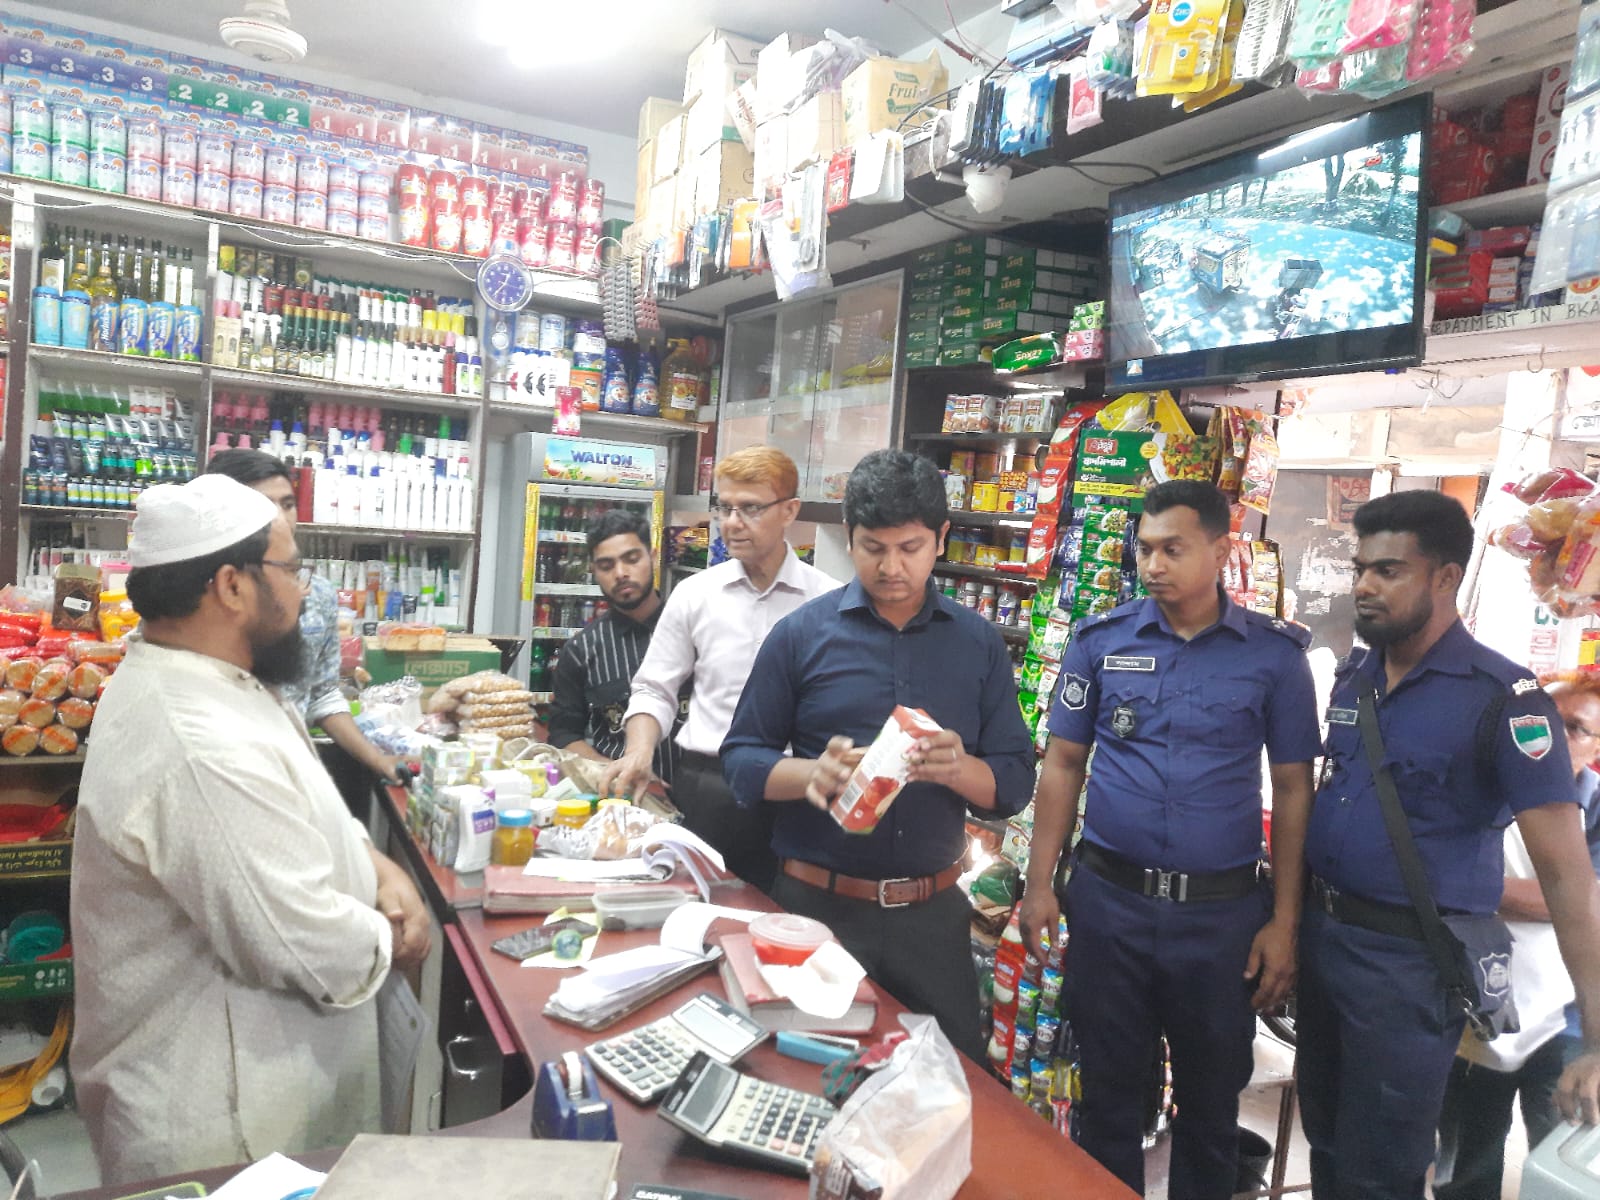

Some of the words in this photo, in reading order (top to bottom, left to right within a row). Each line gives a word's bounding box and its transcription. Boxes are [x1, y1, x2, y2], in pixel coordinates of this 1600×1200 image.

[20, 49, 33, 64] 3
[61, 58, 74, 73] 3
[102, 67, 115, 82] 3
[141, 76, 153, 91] 3
[179, 84, 193, 100] 2
[215, 93, 229, 108] 2
[251, 101, 264, 116] 2
[286, 108, 299, 122] 2
[322, 116, 330, 130] 1
[356, 123, 364, 137] 1
[388, 130, 396, 143] 1
[420, 137, 428, 150] 1
[451, 144, 459, 157] 1
[481, 151, 488, 163] 1
[511, 157, 518, 170] 1
[539, 164, 547, 176] 1
[1002, 279, 1020, 289] LEXUS
[997, 300, 1016, 310] LEXUS
[983, 320, 1002, 330] LEXUS
[1445, 312, 1519, 334] PAYMENT
[1530, 309, 1550, 324] IN
[571, 450, 632, 466] WALTON
